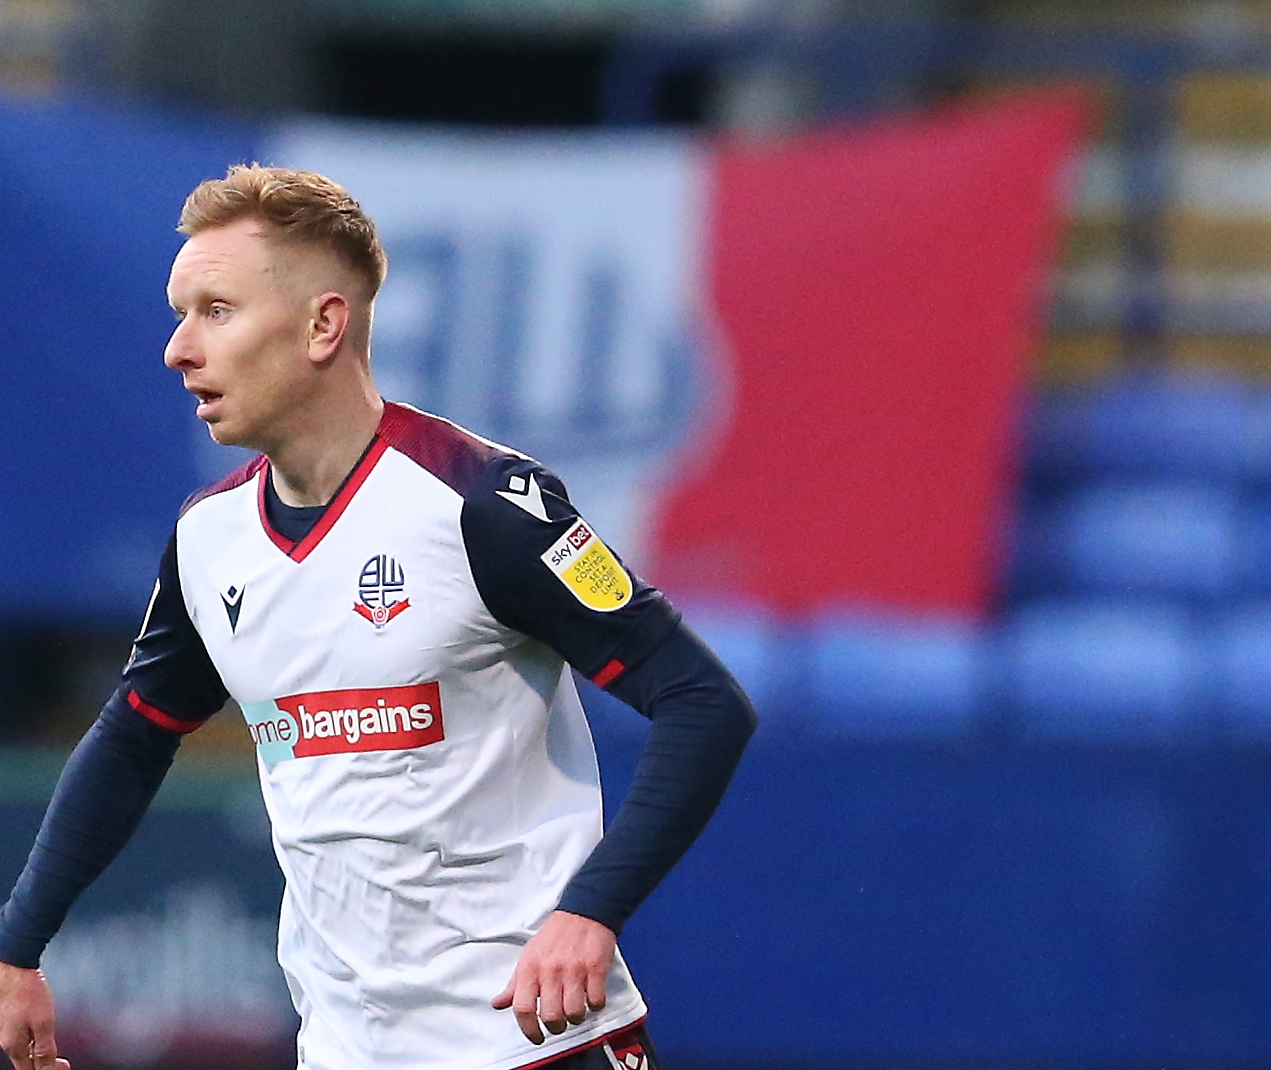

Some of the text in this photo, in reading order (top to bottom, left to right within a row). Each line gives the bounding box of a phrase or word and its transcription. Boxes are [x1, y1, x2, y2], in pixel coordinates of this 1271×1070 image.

[551, 526, 589, 566] sky bet
[297, 698, 434, 745] bargains
